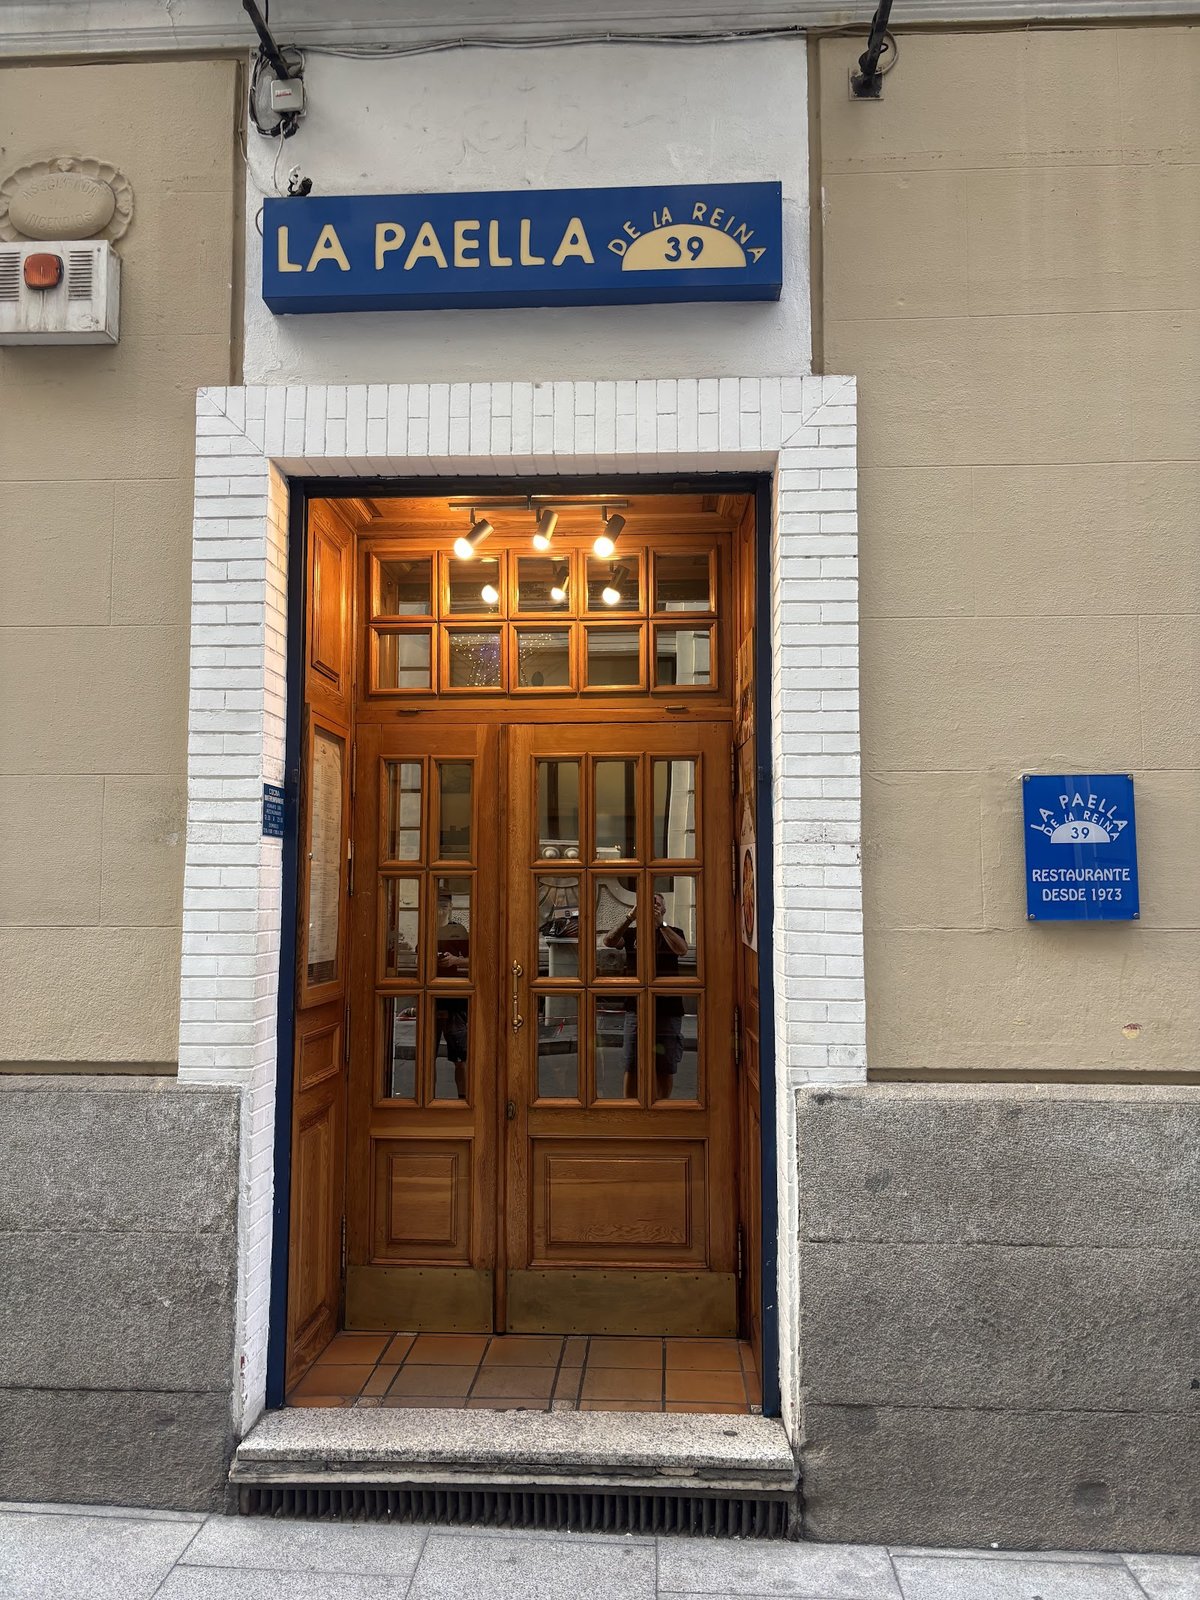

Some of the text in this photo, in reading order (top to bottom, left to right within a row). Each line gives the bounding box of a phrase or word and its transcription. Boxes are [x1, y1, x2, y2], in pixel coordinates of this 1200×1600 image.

[278, 216, 595, 273] LA PAELLA
[608, 201, 767, 264] DE LA REINA
[665, 236, 705, 262] 39
[1030, 793, 1128, 832] LA PAELLA
[1043, 810, 1120, 841] DE LA REINA
[1070, 826, 1090, 840] 39
[1032, 867, 1131, 882] RESTAURANTE
[1042, 887, 1122, 902] DESDE 1973
